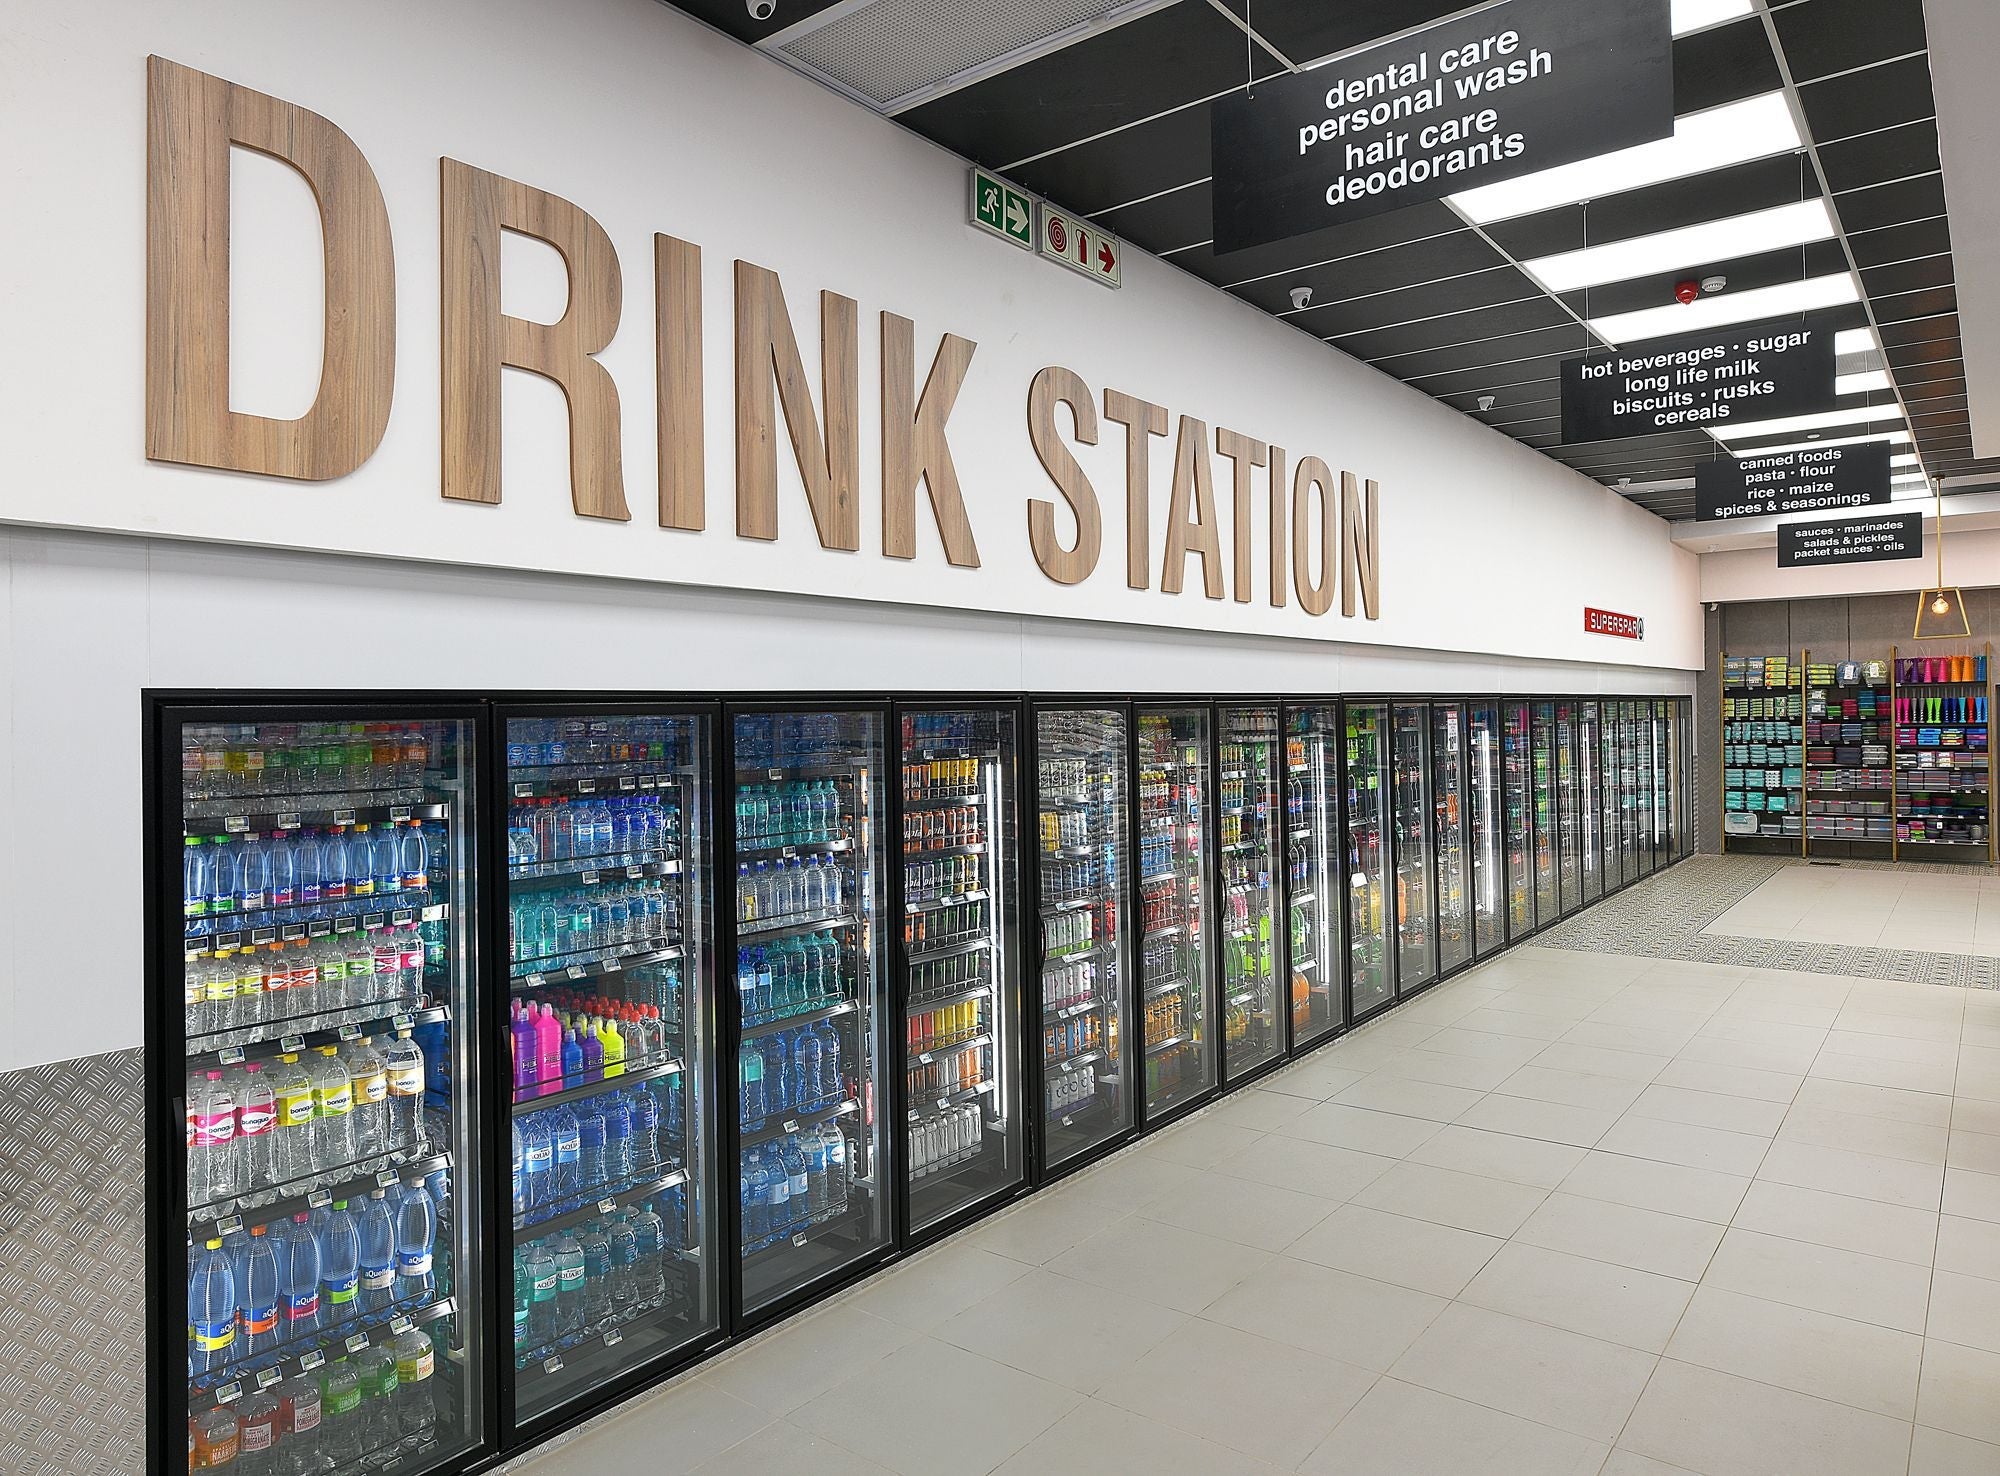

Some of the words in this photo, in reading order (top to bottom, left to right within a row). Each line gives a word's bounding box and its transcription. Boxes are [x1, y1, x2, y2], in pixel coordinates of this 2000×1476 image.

[1325, 52, 1427, 110] dental
[1439, 30, 1519, 73] care
[1300, 78, 1443, 155] personal
[1455, 48, 1552, 100] wash
[1345, 131, 1409, 171] hair
[1419, 108, 1498, 149] care
[1325, 132, 1525, 206] deodorants
[146, 54, 981, 568] DRINK
[1027, 366, 1380, 620] STATION
[1581, 362, 1613, 379] hot
[1619, 344, 1726, 374] beverages
[1746, 330, 1811, 353] sugar
[1625, 373, 1669, 393] long
[1676, 367, 1708, 385] life
[1714, 359, 1760, 379] milk
[1613, 390, 1693, 415] biscuits
[1714, 379, 1775, 401] rusks
[1654, 403, 1730, 426] cereals
[1740, 454, 1794, 470] canned
[1799, 449, 1842, 463] foods
[1746, 470, 1786, 486] pasta
[1799, 464, 1836, 478] flour
[1747, 488, 1775, 500] rice
[1789, 482, 1834, 496] maize
[1715, 502, 1762, 518] spices
[1766, 501, 1778, 512] &
[1781, 492, 1871, 510] seasonings
[1795, 527, 1834, 538] sauces
[1844, 521, 1904, 533] marinades
[1803, 538, 1839, 548] salads
[1843, 536, 1851, 545] &
[1854, 534, 1895, 546] pickles
[1794, 547, 1831, 560] packet
[1833, 544, 1873, 555] sauces
[1883, 542, 1905, 551] oils
[1590, 612, 1637, 635] SUPERSPAR
